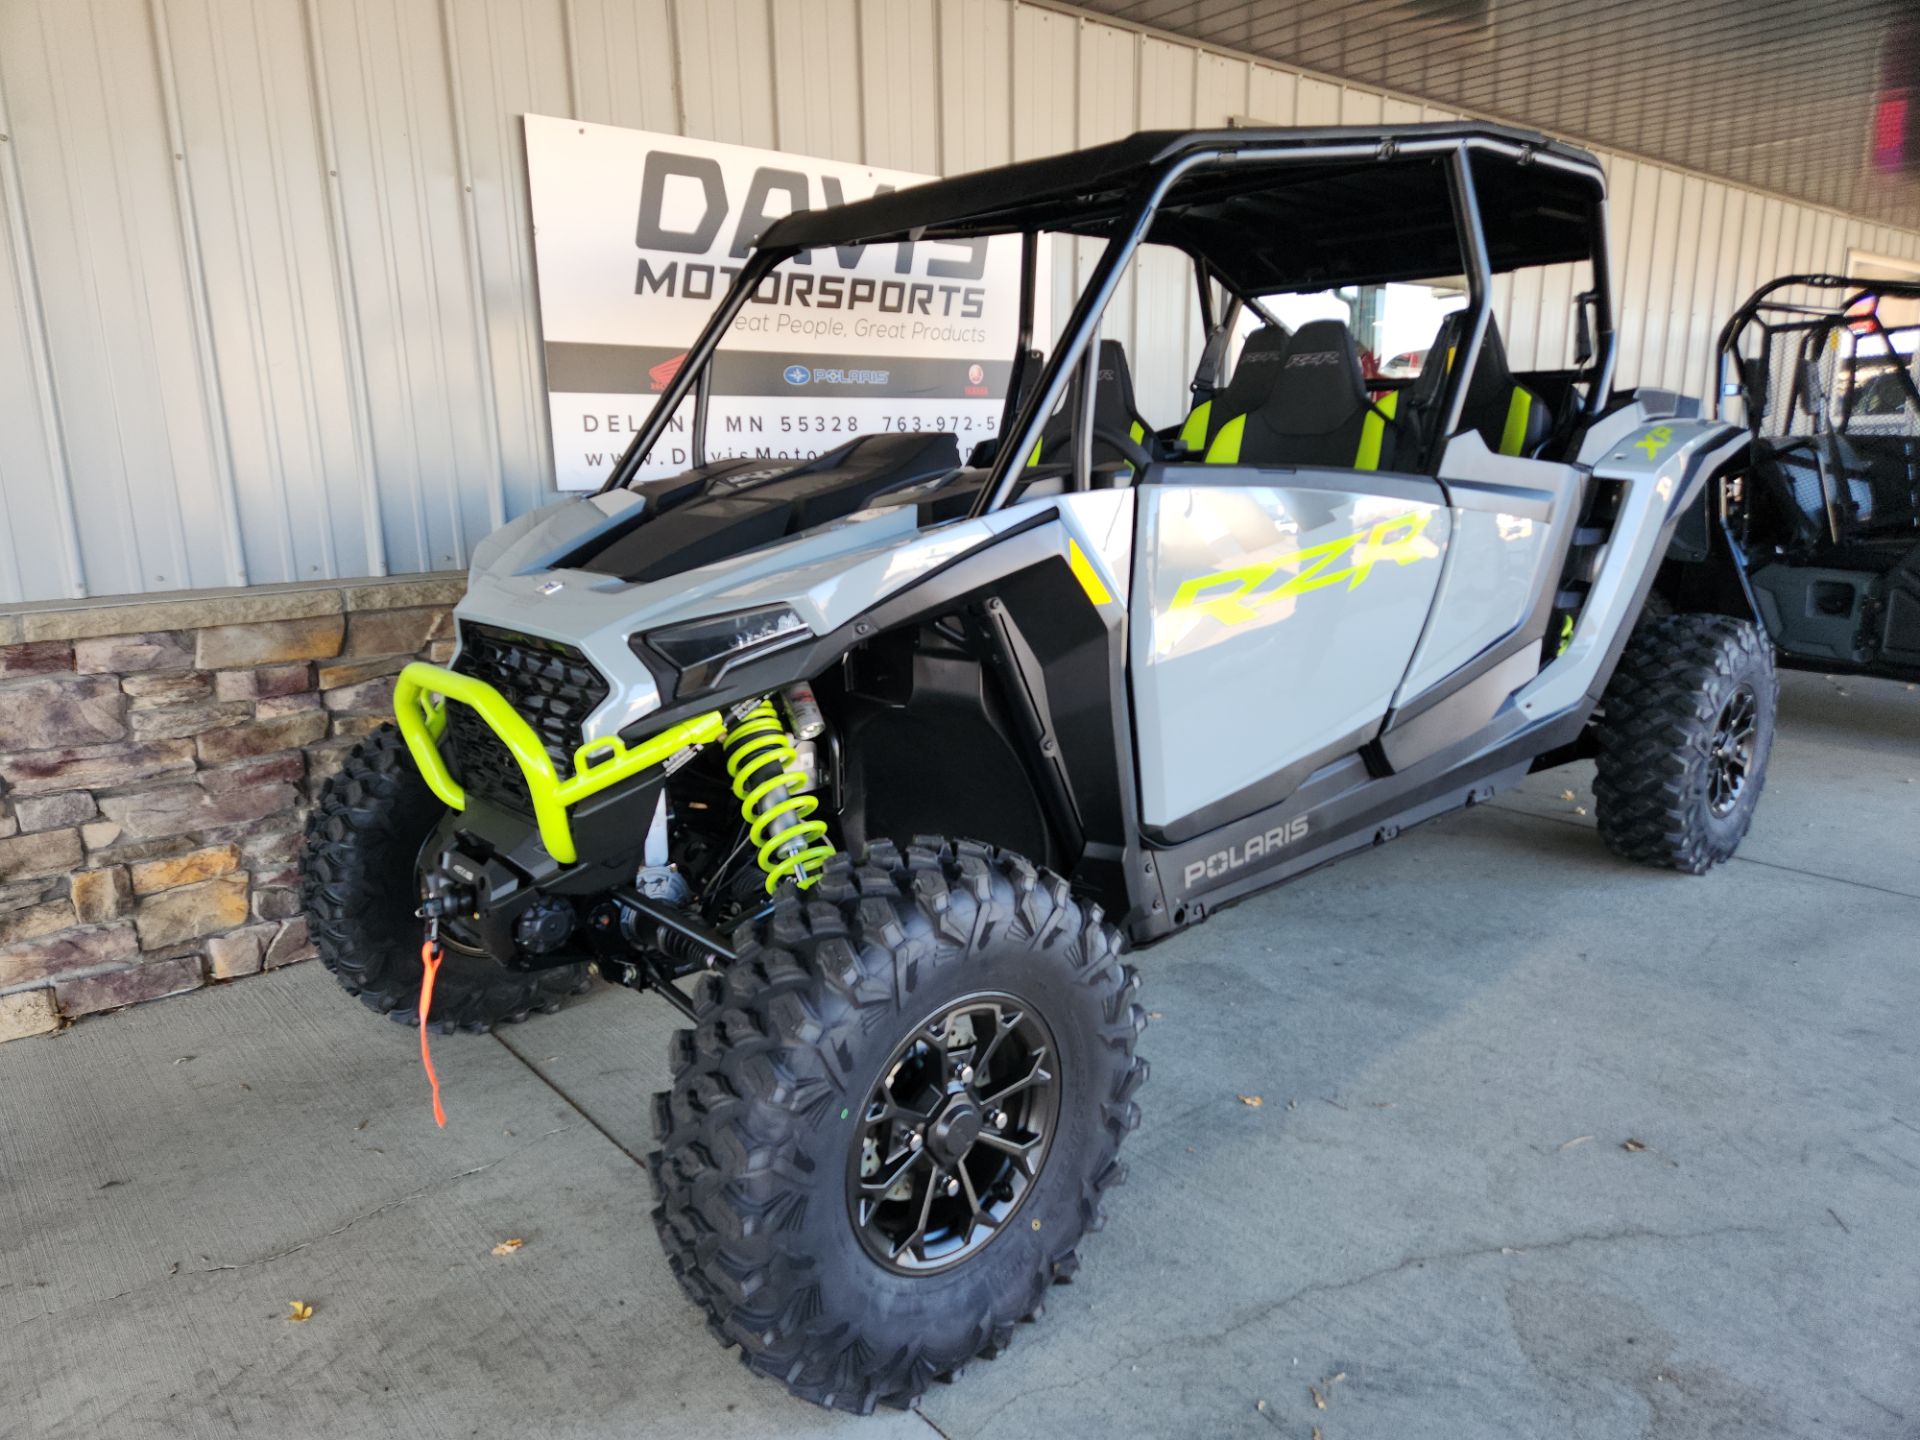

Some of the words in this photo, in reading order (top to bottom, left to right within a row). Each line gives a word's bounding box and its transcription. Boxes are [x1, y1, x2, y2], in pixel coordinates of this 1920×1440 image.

[634, 258, 986, 318] MOTORSPORTS
[735, 314, 769, 333] eat
[776, 313, 847, 338] People,
[854, 318, 906, 340] Great
[911, 321, 986, 343] Products
[813, 368, 890, 384] POLARIS
[583, 415, 690, 433] DELN
[726, 416, 763, 432] MN
[780, 416, 859, 432] 55328
[882, 416, 996, 432] 763-972-5
[1157, 508, 1432, 656] RZR
[1184, 815, 1310, 889] POLARIS
